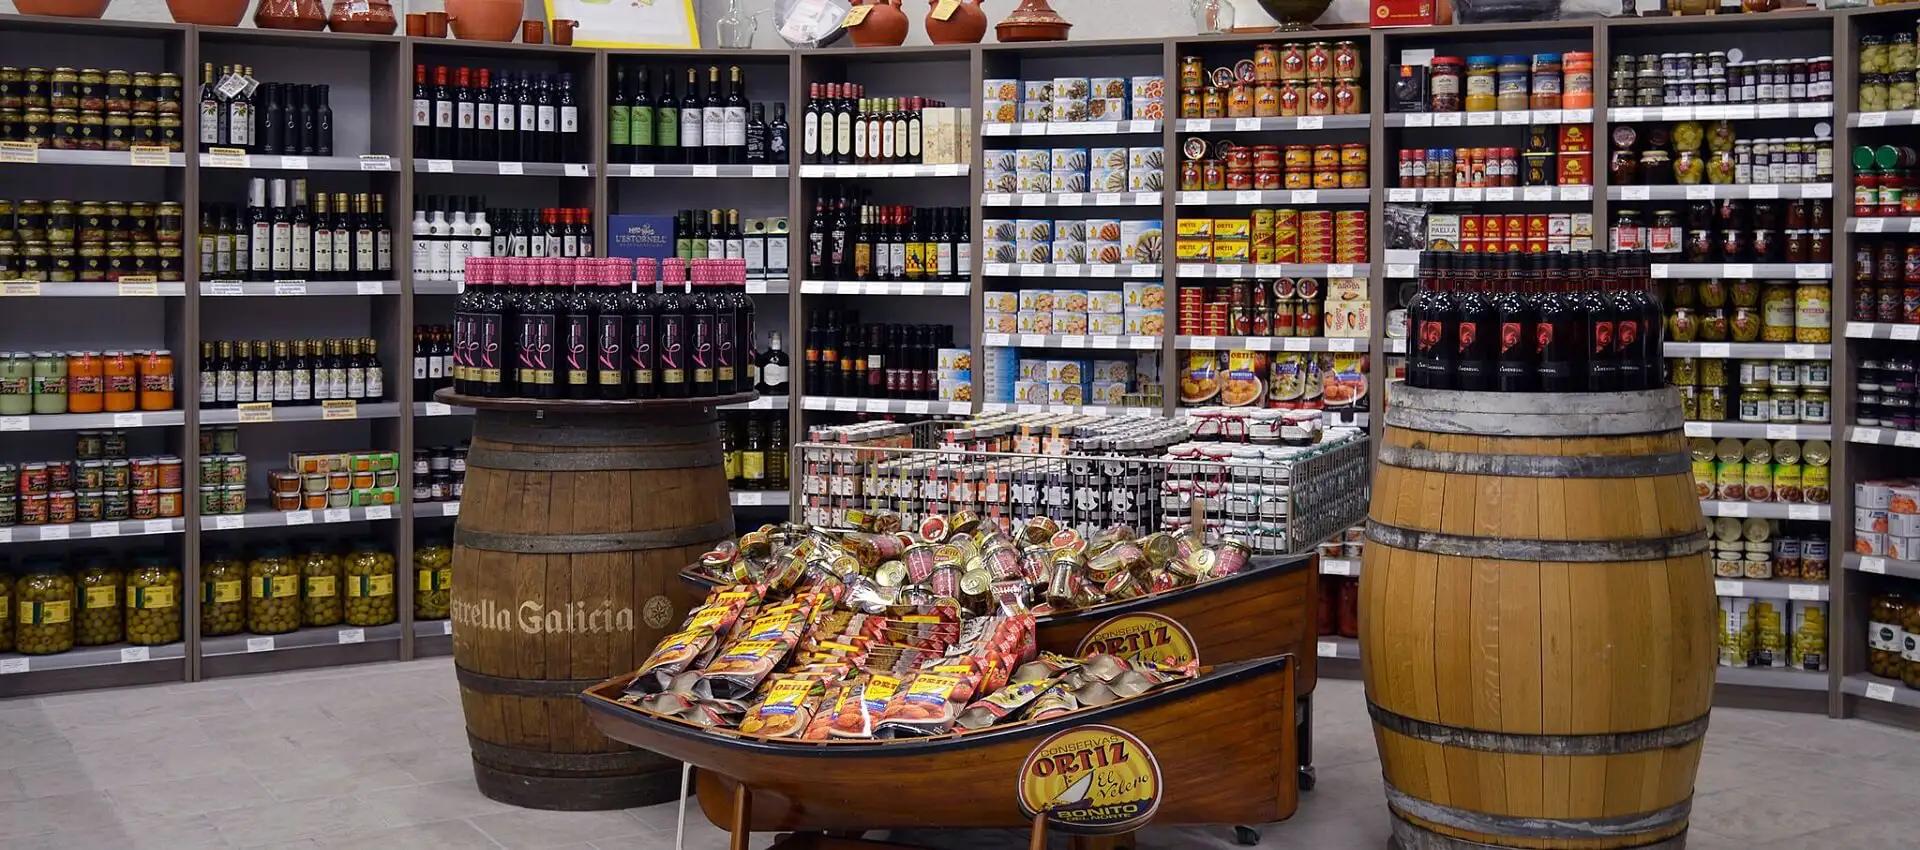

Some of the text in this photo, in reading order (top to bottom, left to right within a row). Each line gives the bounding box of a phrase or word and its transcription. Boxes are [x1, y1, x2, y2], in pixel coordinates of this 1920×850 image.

[615, 235, 667, 244] L'ESTORNELL
[452, 597, 636, 634] strella Galicia
[1094, 621, 1165, 640] CONSERVAS
[1085, 626, 1171, 656] ORTIZ
[872, 680, 898, 689] ORT
[918, 678, 956, 687] ORTIZ
[1040, 735, 1120, 758] CONSERVAS
[1032, 741, 1129, 777] ORTIZ
[1097, 770, 1114, 788] El
[1097, 773, 1149, 799] Velero
[1057, 803, 1138, 819] BONITO
